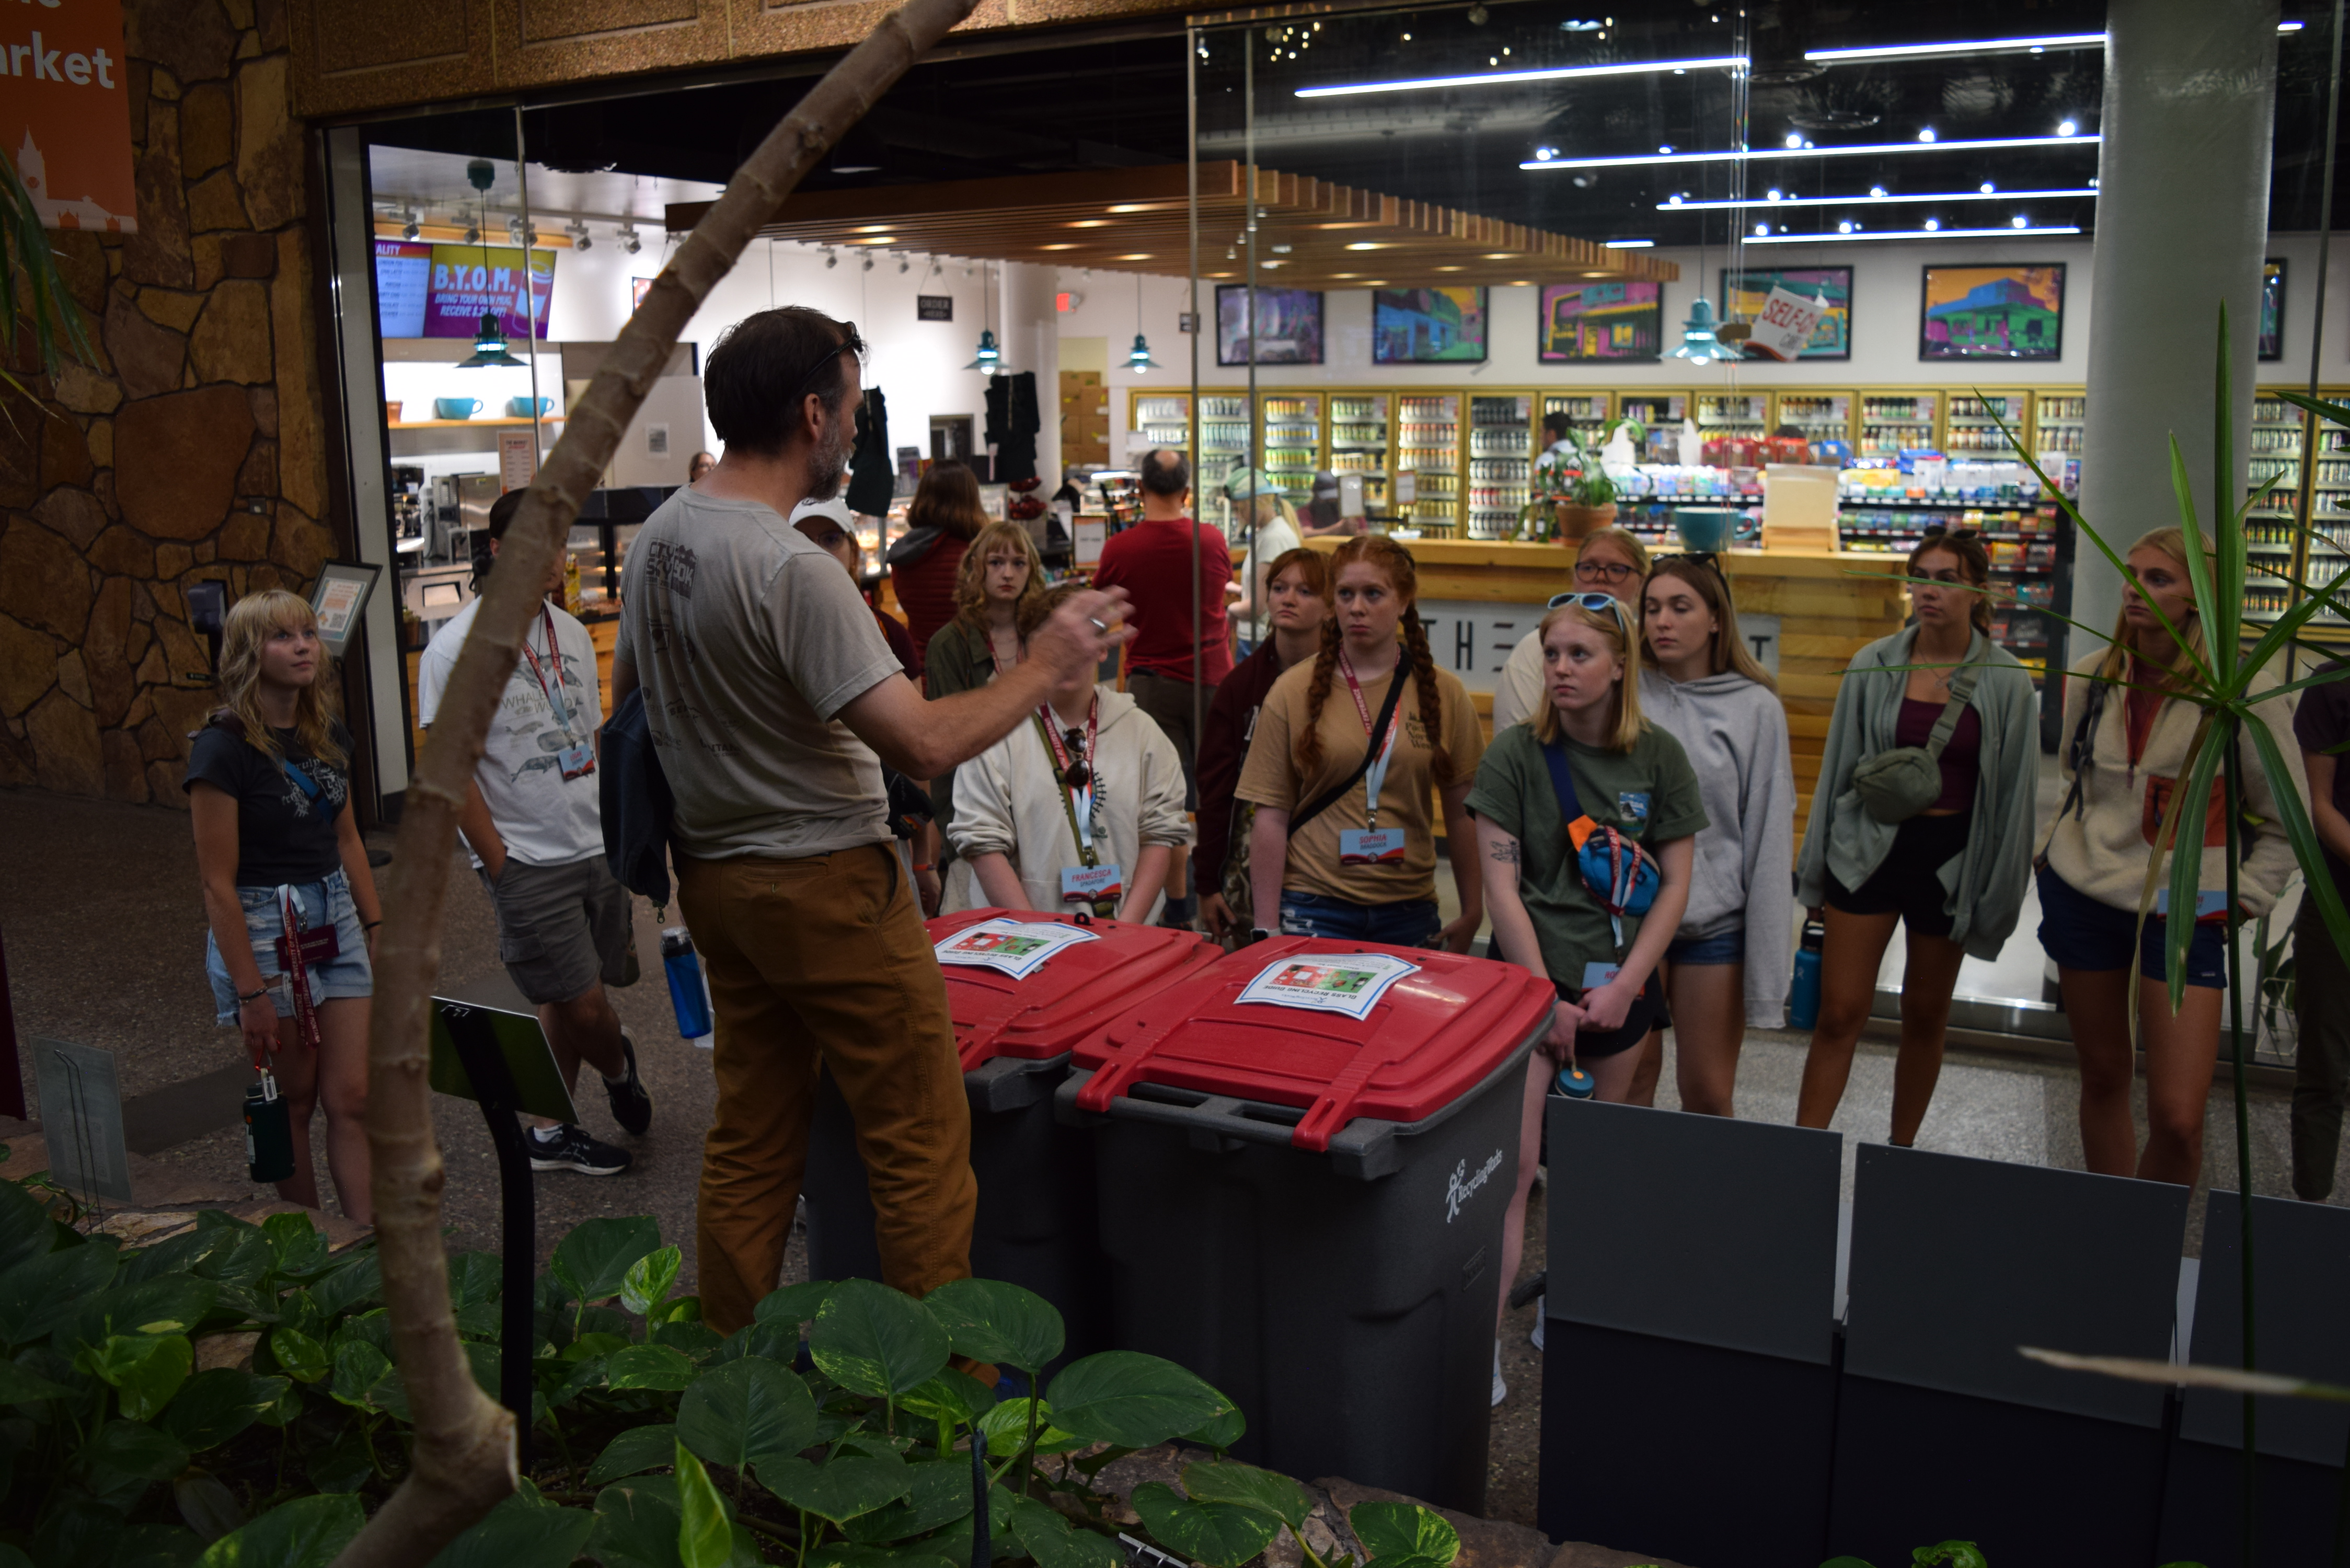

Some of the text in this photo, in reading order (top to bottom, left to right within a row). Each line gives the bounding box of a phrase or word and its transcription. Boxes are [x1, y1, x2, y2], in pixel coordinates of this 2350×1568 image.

[376, 244, 400, 255] ALITY
[434, 264, 516, 292] B.Y.O.M.
[434, 294, 459, 304] BRING
[459, 294, 478, 304] YOUR
[440, 305, 471, 317] RECEIVE
[502, 688, 547, 709] WHALE
[1044, 717, 1061, 748] UNIVERSITY
[1360, 834, 1387, 844] SOPHIA
[1072, 869, 1112, 882] FRANCESCA
[284, 912, 294, 939] MONTANA
[290, 939, 296, 948] OF
[291, 948, 301, 981] UNIVERSITY
[1287, 988, 1330, 997] RECYCLING
[295, 993, 305, 1024] EXPERIENCE
[309, 1016, 321, 1044] MONTANA
[1458, 1148, 1503, 1203] RecyclingWorks
